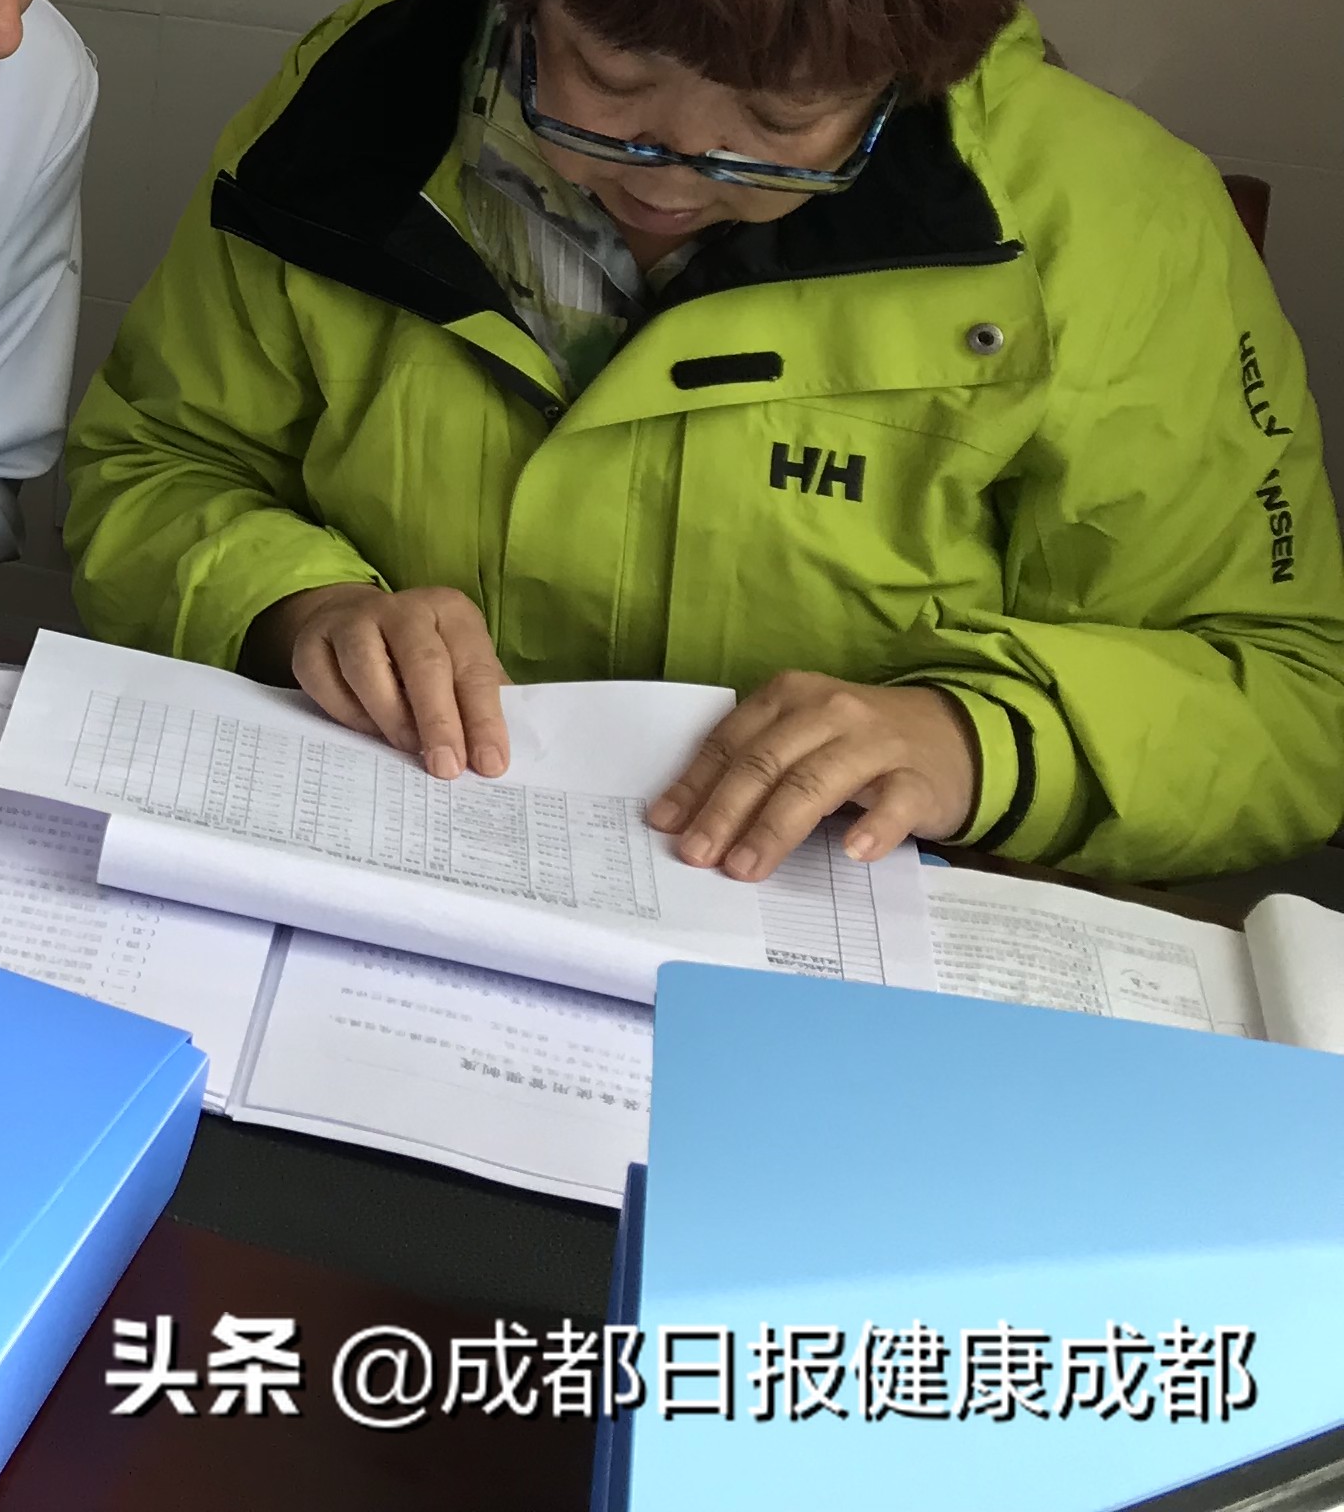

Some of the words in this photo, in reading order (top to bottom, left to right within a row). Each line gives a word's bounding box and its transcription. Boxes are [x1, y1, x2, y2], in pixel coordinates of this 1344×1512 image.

[1256, 469, 1294, 585] NSEN
[456, 1057, 650, 1116] 装备使用管理制度
